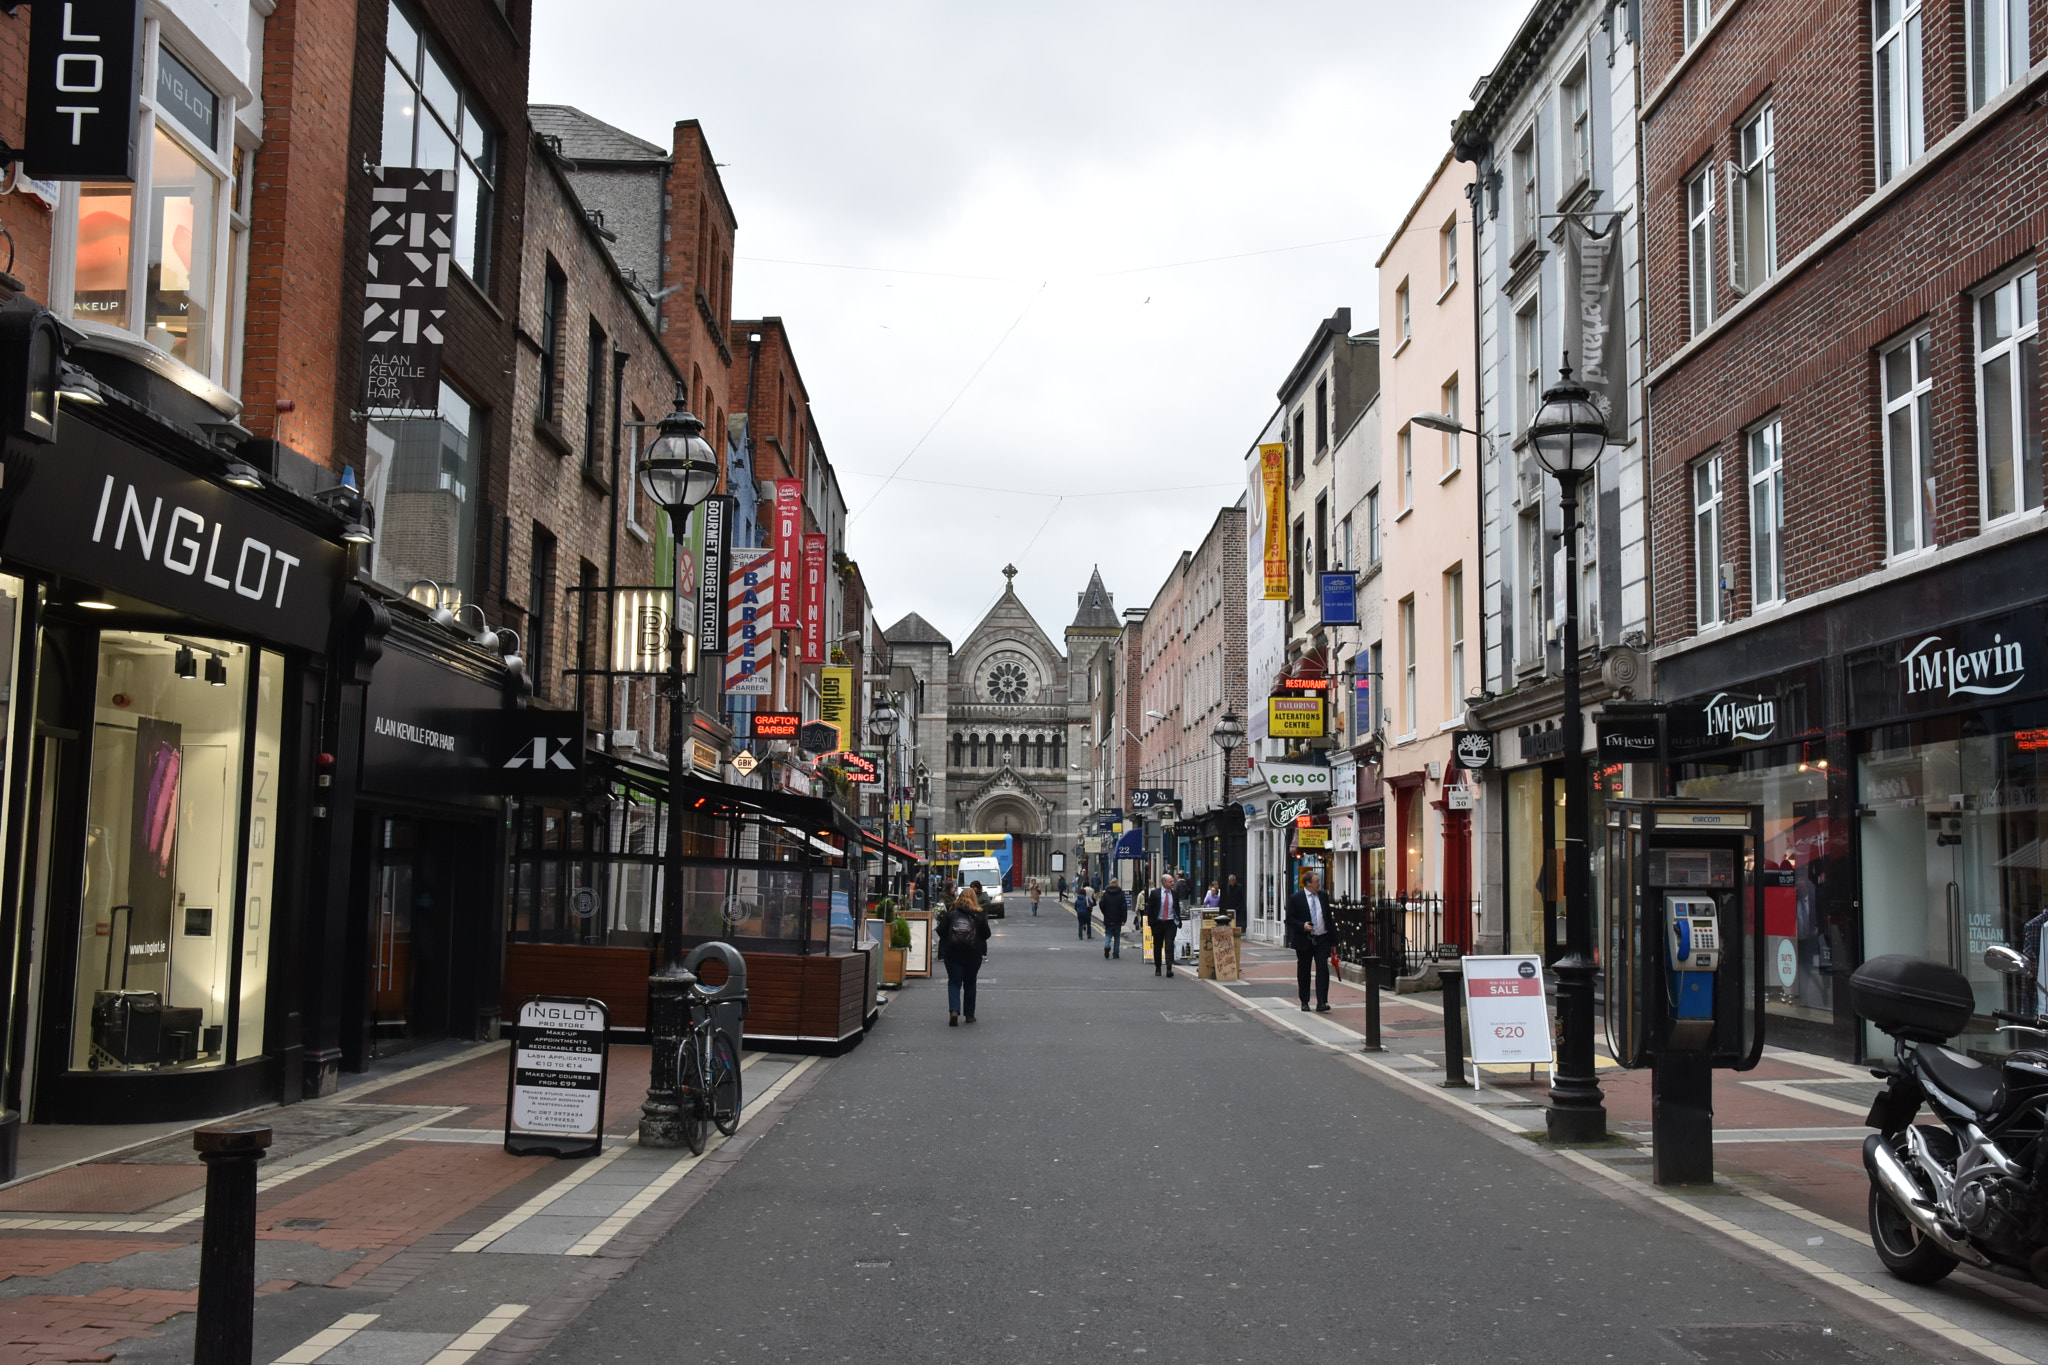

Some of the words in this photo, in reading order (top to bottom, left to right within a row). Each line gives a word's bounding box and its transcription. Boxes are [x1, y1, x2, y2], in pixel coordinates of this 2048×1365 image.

[1580, 236, 1612, 385] Timberland
[370, 353, 410, 366] ALAN
[369, 365, 426, 378] KEVILLE
[368, 376, 398, 388] FOR
[367, 387, 401, 399] HAIR
[706, 500, 720, 553] GOURMET
[1271, 486, 1279, 558] ALTERATION
[92, 475, 300, 609] INGLOT
[705, 556, 718, 599] BURGER
[779, 519, 792, 623] DINER
[808, 568, 818, 658] DINER
[703, 601, 716, 650] KITCHEN
[741, 571, 759, 675] BARBER
[823, 677, 847, 721] GOTHAM
[755, 716, 799, 725] GRAFTON
[1284, 721, 1310, 729] CENTRE
[374, 716, 396, 738] ALAN
[396, 721, 425, 744] KEVILLE
[425, 729, 439, 748] FOR
[439, 733, 455, 752] HAIR
[757, 726, 795, 735] BARBER
[802, 729, 835, 748] EAT
[737, 759, 753, 767] GBK
[846, 773, 875, 782] OUNGE
[1282, 774, 1304, 787] cig
[1308, 773, 1327, 783] co
[1133, 792, 1149, 807] 22
[246, 750, 270, 969] INGLOT
[1968, 913, 1992, 926] LOVE
[1969, 927, 2004, 941] ITALIAN
[129, 940, 166, 956] www.inglot.ie
[1490, 985, 1520, 995] SALE
[528, 1007, 598, 1021] INGLOT
[1494, 1026, 1525, 1039] €20
[534, 1037, 588, 1045] APPOINTMENTS
[548, 1054, 593, 1062] APPLICATION
[558, 1073, 592, 1081] COURSES
